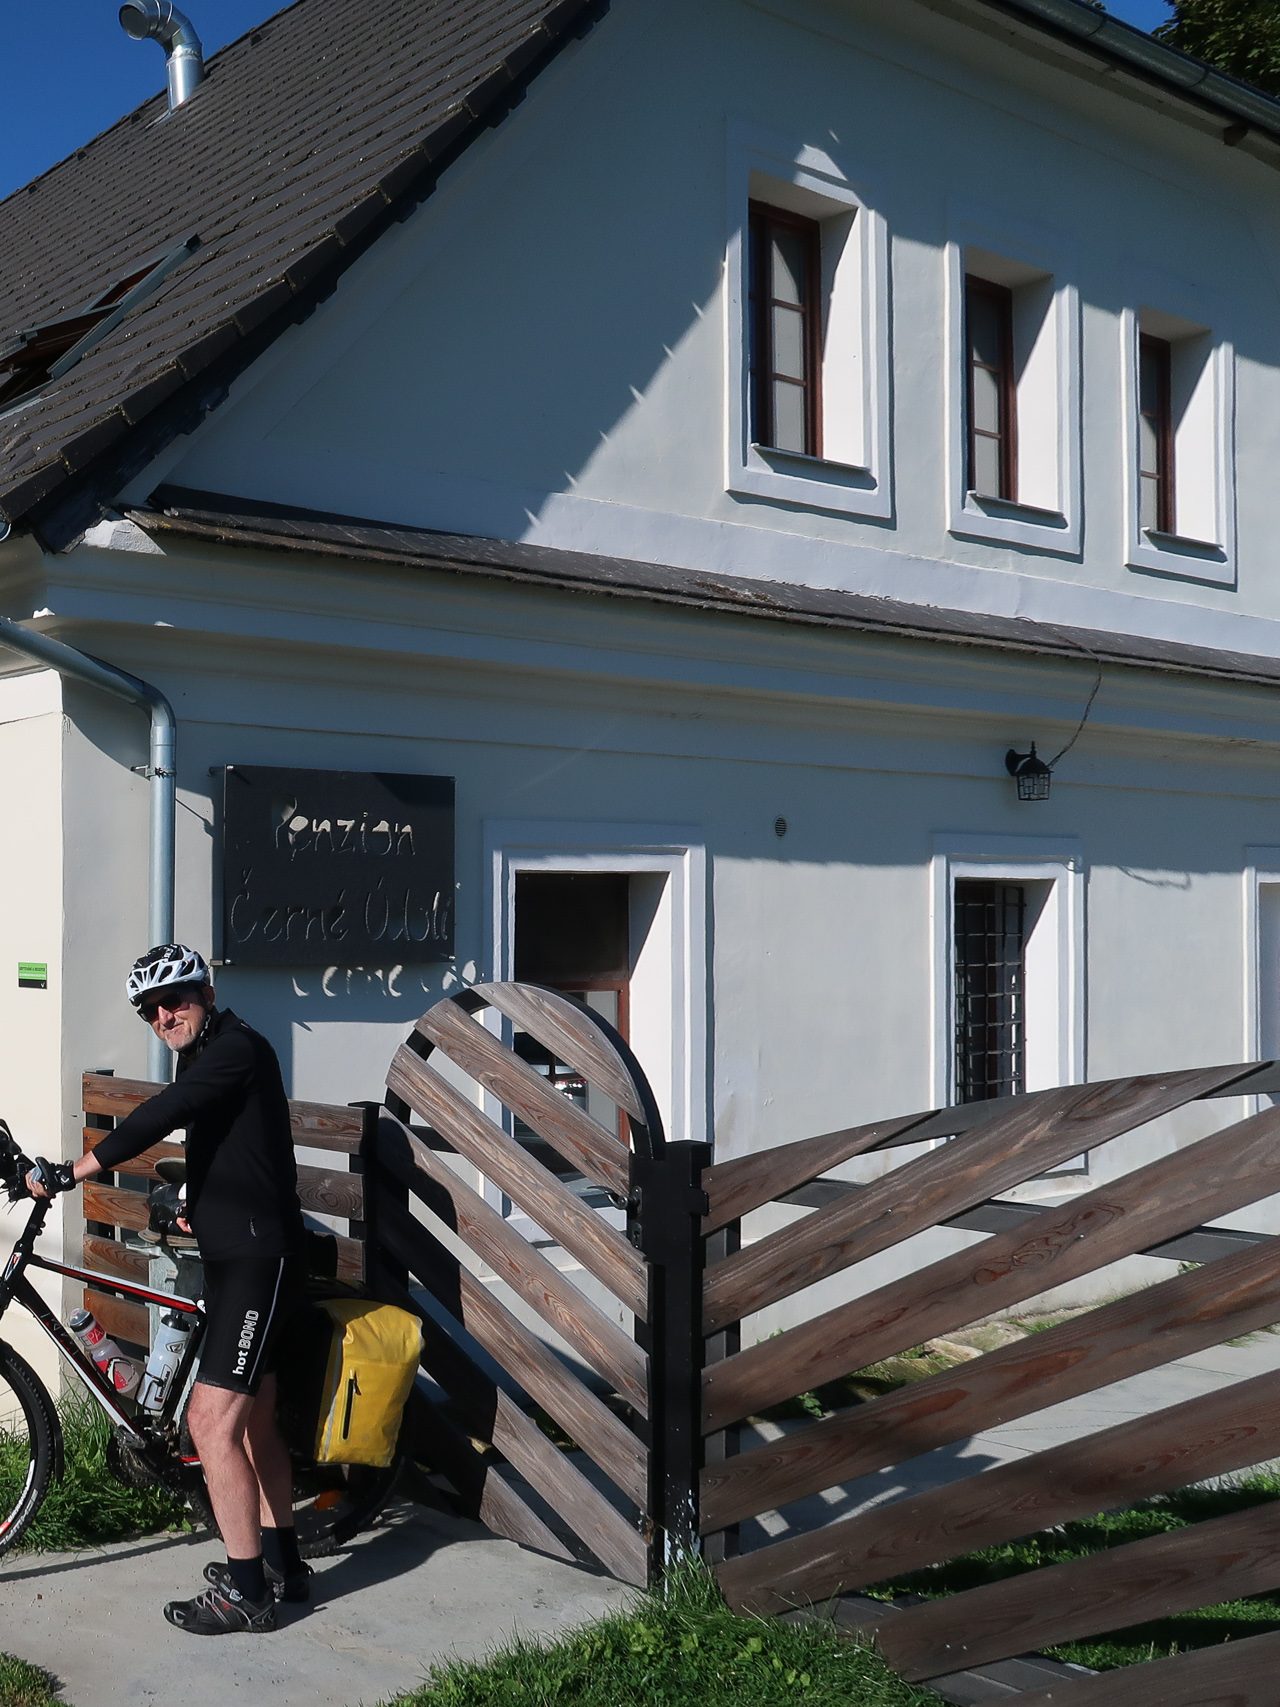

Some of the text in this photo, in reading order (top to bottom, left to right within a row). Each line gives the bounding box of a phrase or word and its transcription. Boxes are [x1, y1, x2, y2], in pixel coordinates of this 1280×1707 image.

[272, 797, 415, 860] Penzion
[232, 1309, 260, 1375] hot BOND
